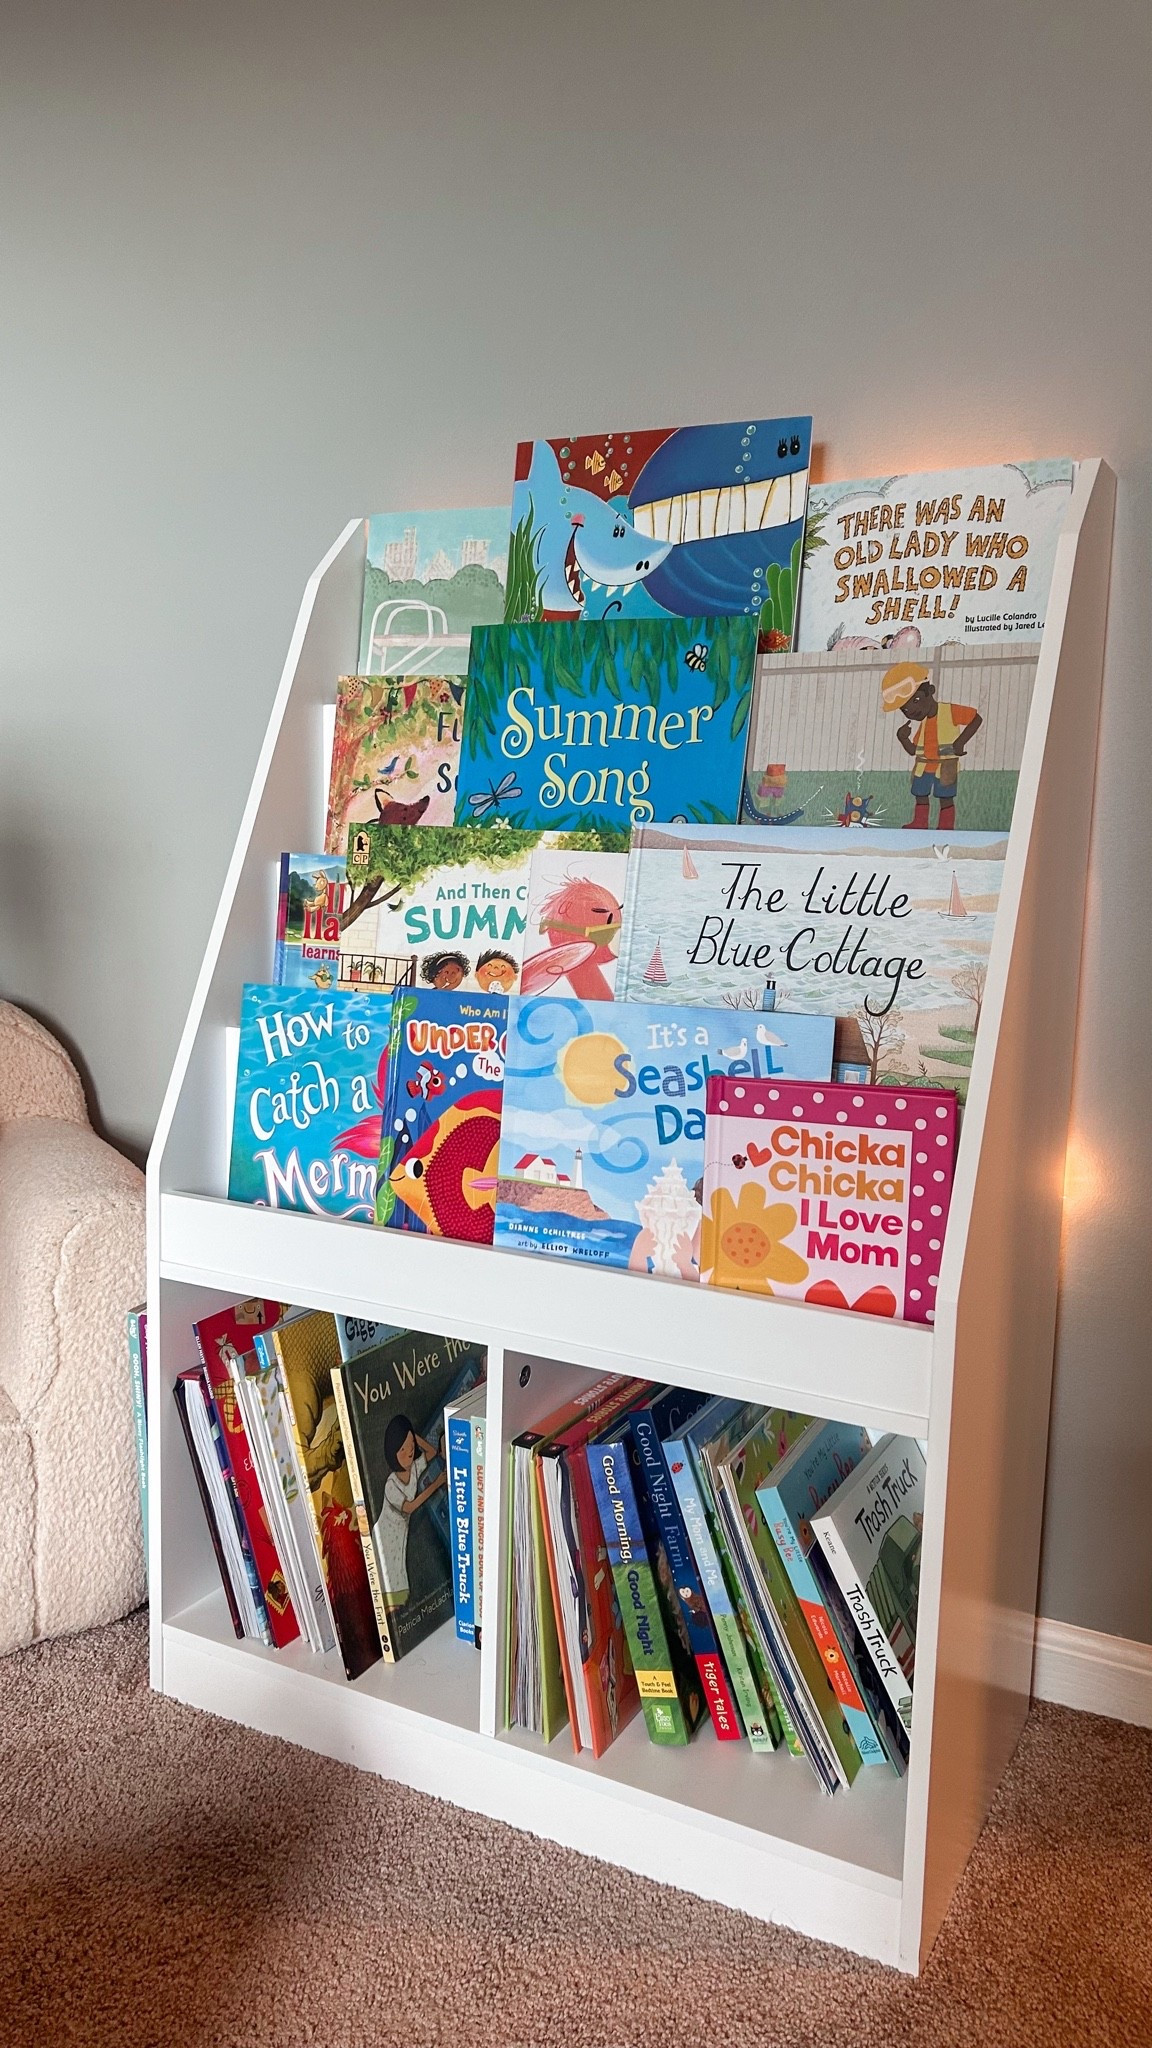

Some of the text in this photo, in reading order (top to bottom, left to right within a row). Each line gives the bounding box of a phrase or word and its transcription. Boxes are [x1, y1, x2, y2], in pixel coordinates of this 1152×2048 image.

[838, 494, 1005, 540] THERE WAS AN
[834, 530, 1029, 571] OLD LADY WHO
[834, 565, 1028, 603] SWALLOWED A
[865, 594, 961, 625] SHELL!
[965, 612, 1037, 624] by Lucille Colandro
[965, 623, 1001, 632] Illustrated
[1003, 623, 1013, 632] by
[1015, 622, 1036, 630] Jared
[500, 687, 713, 759] Summer
[538, 753, 655, 823] Song
[436, 883, 466, 901] And
[471, 882, 510, 901] Then
[721, 863, 913, 918] The Little
[686, 915, 927, 1017] Blue Cottage
[460, 1004, 481, 1017] Who
[483, 1008, 500, 1018] Am
[255, 1002, 370, 1067] How to
[647, 1023, 709, 1049] It's a
[478, 1057, 501, 1077] The
[249, 1061, 373, 1142] Catch a
[654, 1104, 706, 1145] Da
[770, 1125, 906, 1168] Chicka
[768, 1160, 905, 1203] Chicka
[508, 1223, 586, 1240] DIANNE OCHILTREE
[800, 1198, 904, 1236] I Love
[529, 1240, 538, 1249] by
[541, 1242, 568, 1253] ELLIOT
[572, 1247, 610, 1259] KRELOFF
[806, 1230, 899, 1268] Mom
[353, 1373, 391, 1414] You
[393, 1349, 441, 1390] Were
[444, 1336, 471, 1363] the
[476, 1464, 484, 1492] BLUEY
[636, 1422, 684, 1568] Good Night Farm
[477, 1495, 485, 1513] AND
[854, 1491, 893, 1544] Trash
[453, 1466, 471, 1604] Little Blue Truck
[602, 1455, 654, 1656] Good Morning, Good Night
[683, 1497, 718, 1586] My Mom and Me
[773, 1521, 794, 1564] Busy Bee
[823, 1531, 837, 1555] Keane
[363, 1543, 385, 1625] You Were the First
[397, 1614, 421, 1636] Patricia
[846, 1583, 875, 1631] Trash
[703, 1660, 730, 1731] tiger tales
